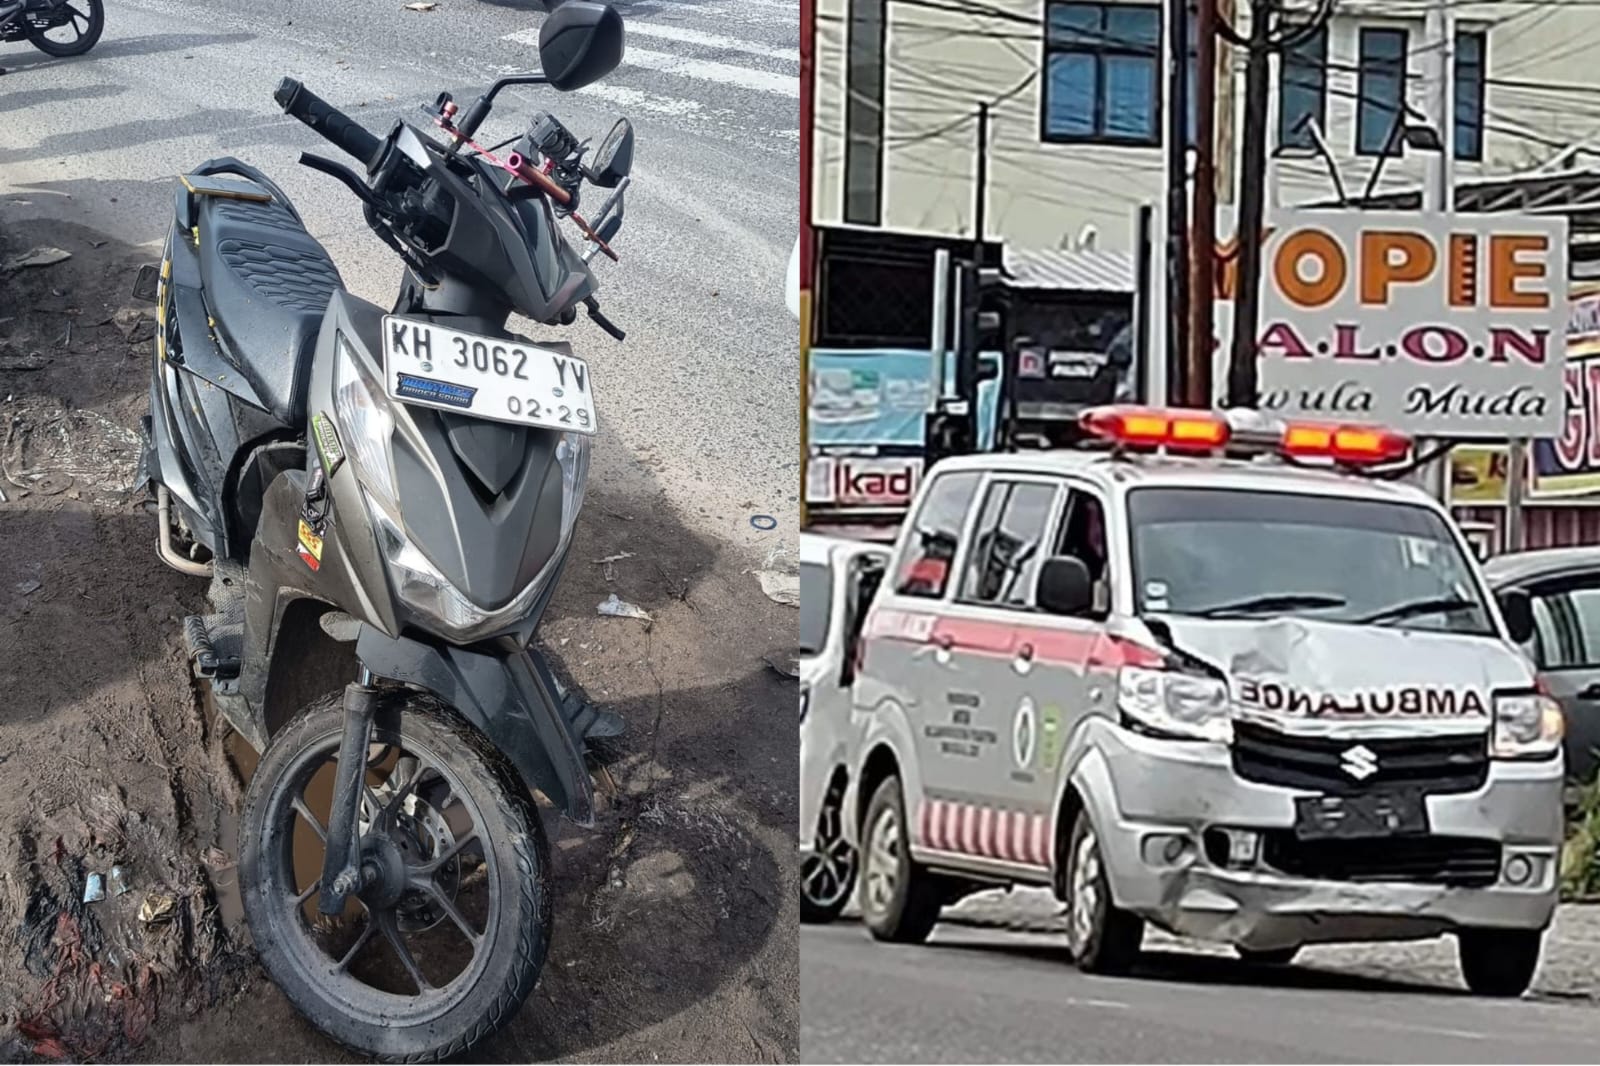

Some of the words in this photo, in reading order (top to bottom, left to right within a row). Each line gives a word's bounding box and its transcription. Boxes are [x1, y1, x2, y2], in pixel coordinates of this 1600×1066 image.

[391, 321, 432, 361] KH
[452, 336, 529, 380] 3062
[553, 356, 584, 392] YV
[1404, 384, 1547, 416] Muda
